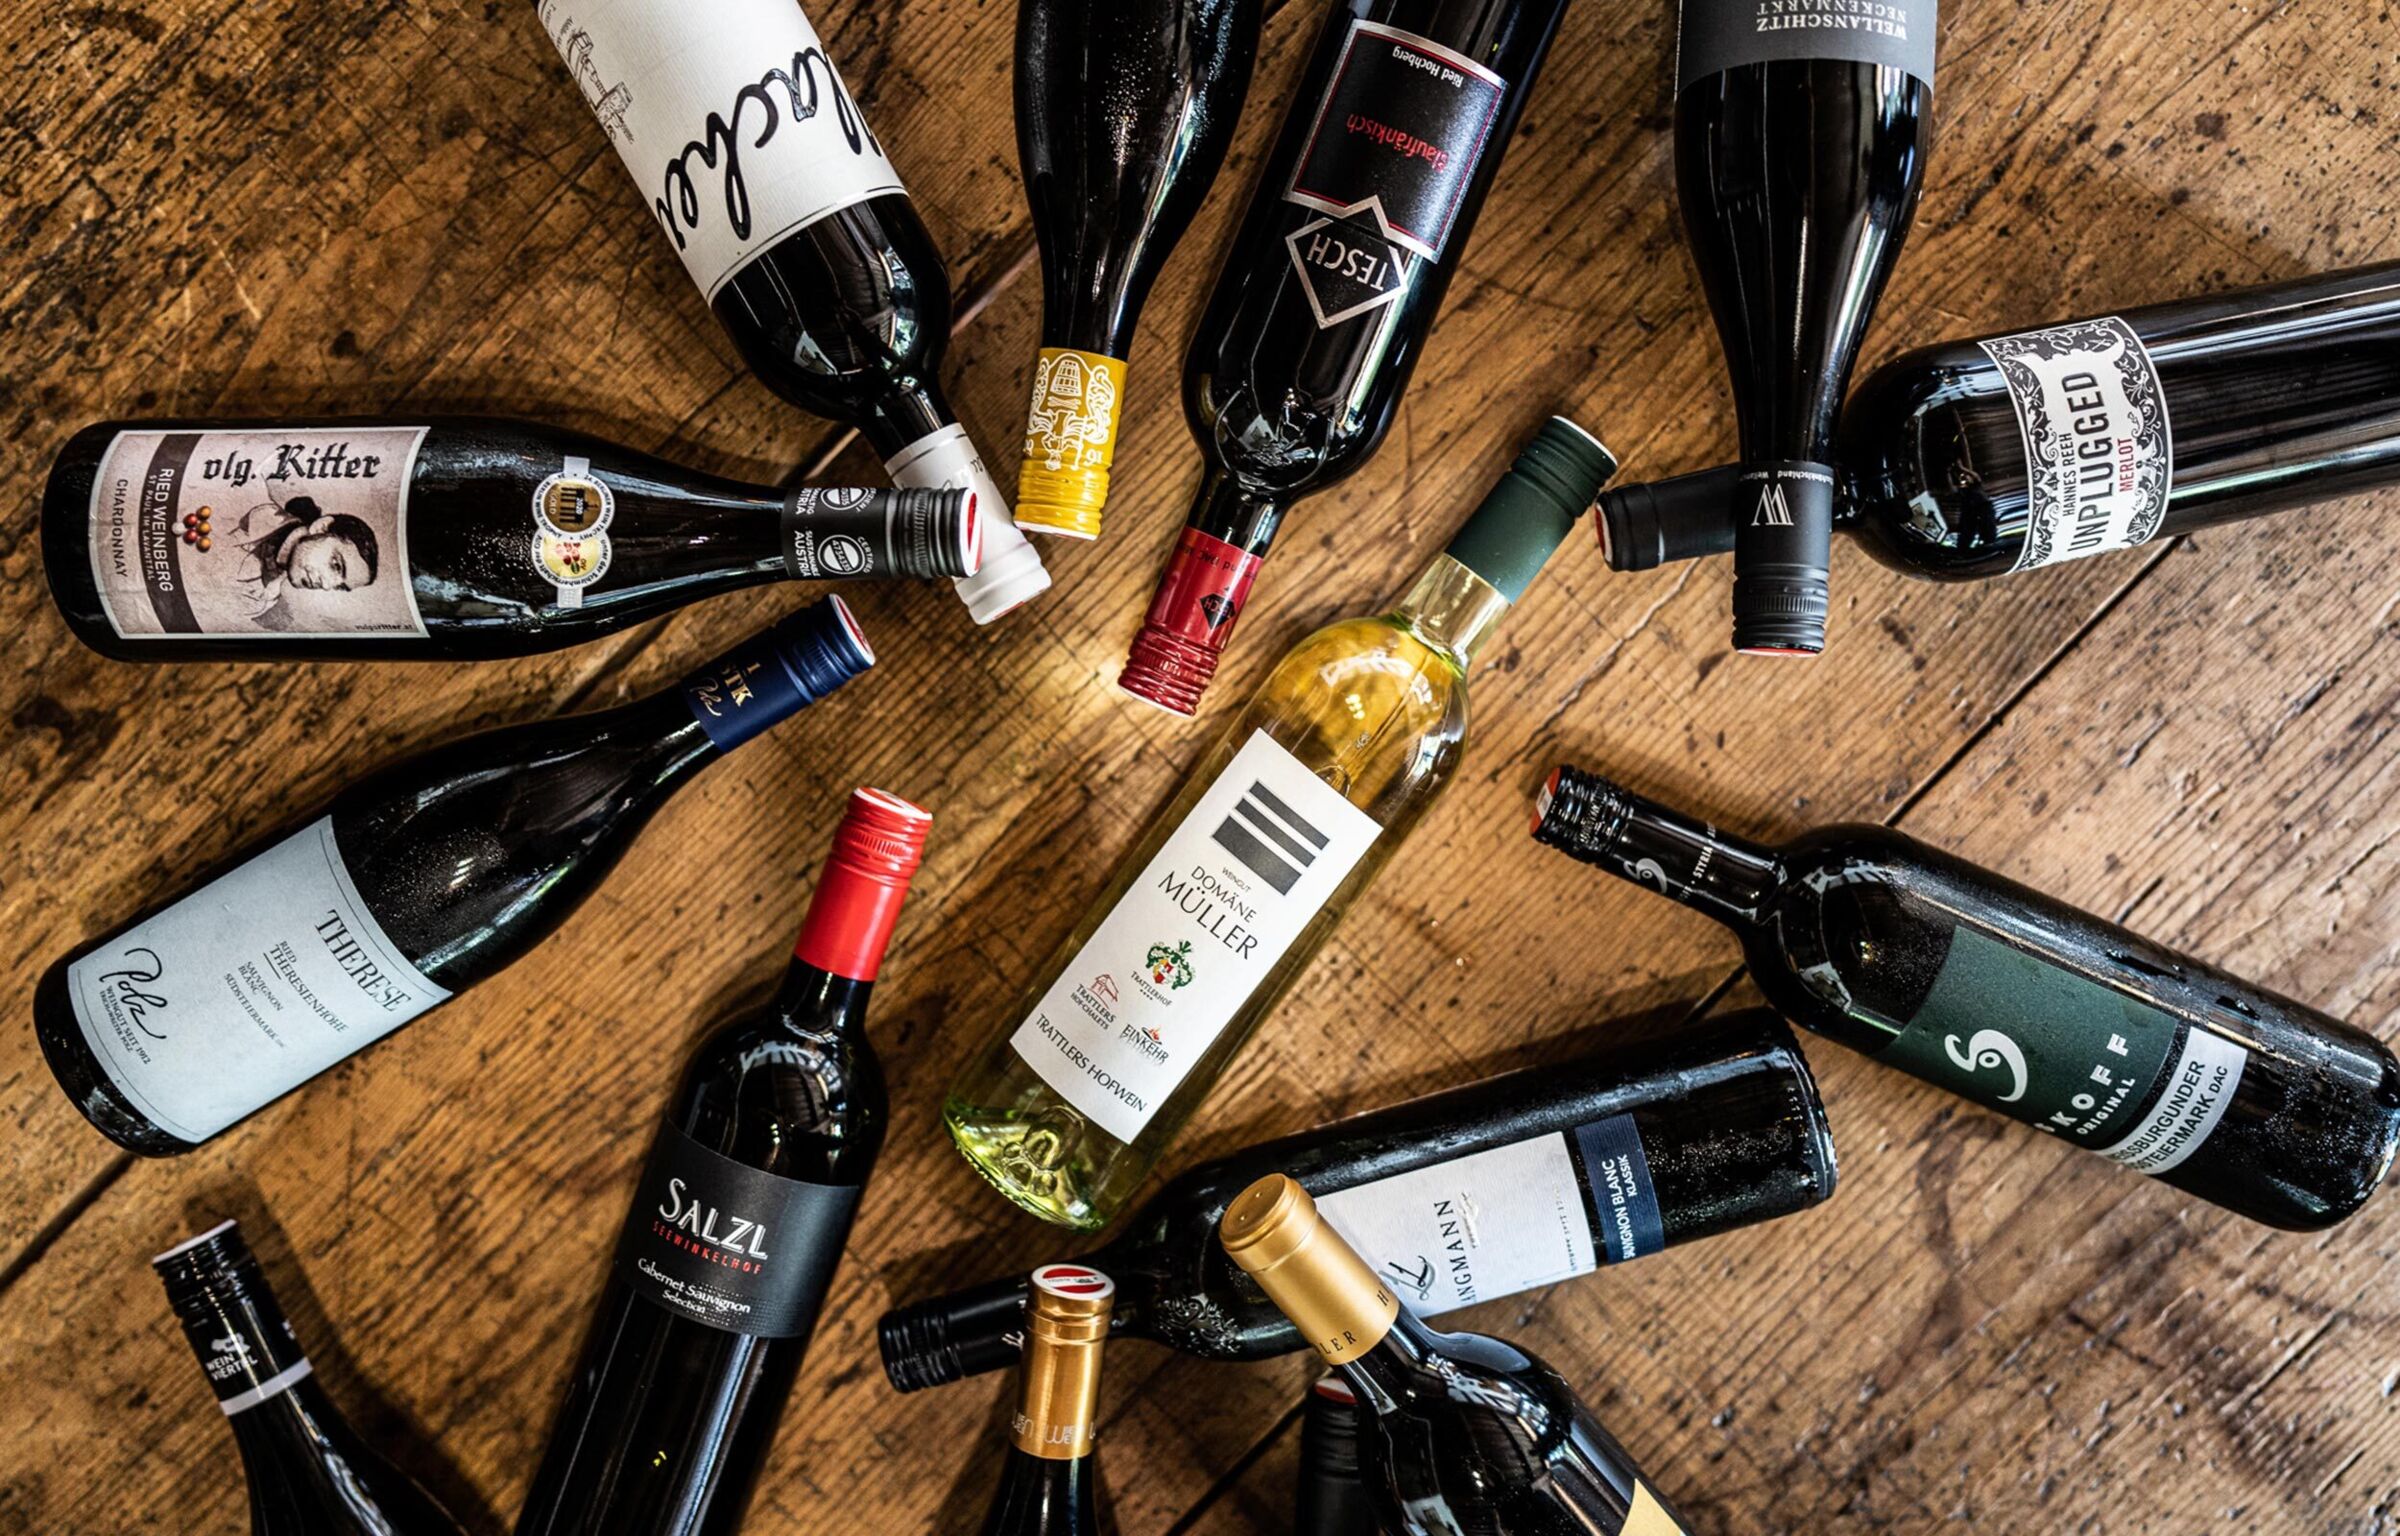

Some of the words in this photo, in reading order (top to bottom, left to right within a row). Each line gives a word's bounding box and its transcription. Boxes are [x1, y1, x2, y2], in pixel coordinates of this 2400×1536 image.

[1755, 12, 1907, 40] WELLANSCHITZ
[1390, 44, 1440, 77] Hochberg
[1440, 66, 1464, 87] Ried
[1305, 231, 1386, 292] TESCH
[267, 441, 381, 482] Ritter
[2058, 431, 2075, 466] REEH
[2060, 370, 2115, 551] UNPLUGGED
[2115, 435, 2135, 492] MERLOT
[142, 489, 153, 512] PAUL
[154, 467, 175, 501] RIED
[575, 497, 583, 515] 2020
[1750, 483, 1794, 525] W
[2063, 469, 2077, 516] HANNES
[110, 478, 129, 577] CHARDONNAY
[142, 515, 150, 526] IM
[142, 529, 155, 581] LAVANTTAL
[151, 505, 174, 592] WEINBERG
[793, 530, 811, 577] AUSTRIA
[856, 536, 873, 573] CERTIFIED
[746, 660, 761, 674] 1
[1221, 866, 1252, 893] WEINGUT
[1691, 845, 1713, 879] STYRIA
[1156, 869, 1260, 961] MÜLLER
[1189, 863, 1257, 924] DOMÄNE
[278, 939, 298, 964] RIED
[313, 907, 411, 1013] THERESE
[98, 947, 168, 1039] Polz
[236, 964, 260, 996] BLANC
[243, 960, 283, 1011] SAUVIGNON
[267, 943, 349, 1033] THERESIENHÖHE
[1129, 970, 1173, 1008] TRATTLERHOF
[104, 984, 127, 1027] WEINGUT
[122, 1026, 139, 1047] SEIT
[134, 1045, 152, 1065] 1912
[1074, 983, 1117, 1023] TRATTLERS
[1034, 1013, 1090, 1069] TRATTLERS
[1085, 1063, 1148, 1113] HOFWEIN
[1120, 1023, 1170, 1063] EINKEHR
[2033, 1030, 2132, 1132] SKOFF
[2206, 1064, 2230, 1094] DAC
[2075, 1073, 2136, 1136] ORIGINAL
[1600, 1157, 1625, 1205] BLANC
[1617, 1153, 1638, 1197] KLASSIK
[656, 1176, 768, 1261] SALZL
[1614, 1205, 1636, 1259] SAUVIGNON
[652, 1219, 763, 1275] SEEWINKELHOF
[636, 1258, 685, 1292] Cabernet
[685, 1283, 751, 1314] Sauvignon
[661, 1288, 707, 1314] Selection
[205, 1351, 235, 1371] WEIN
